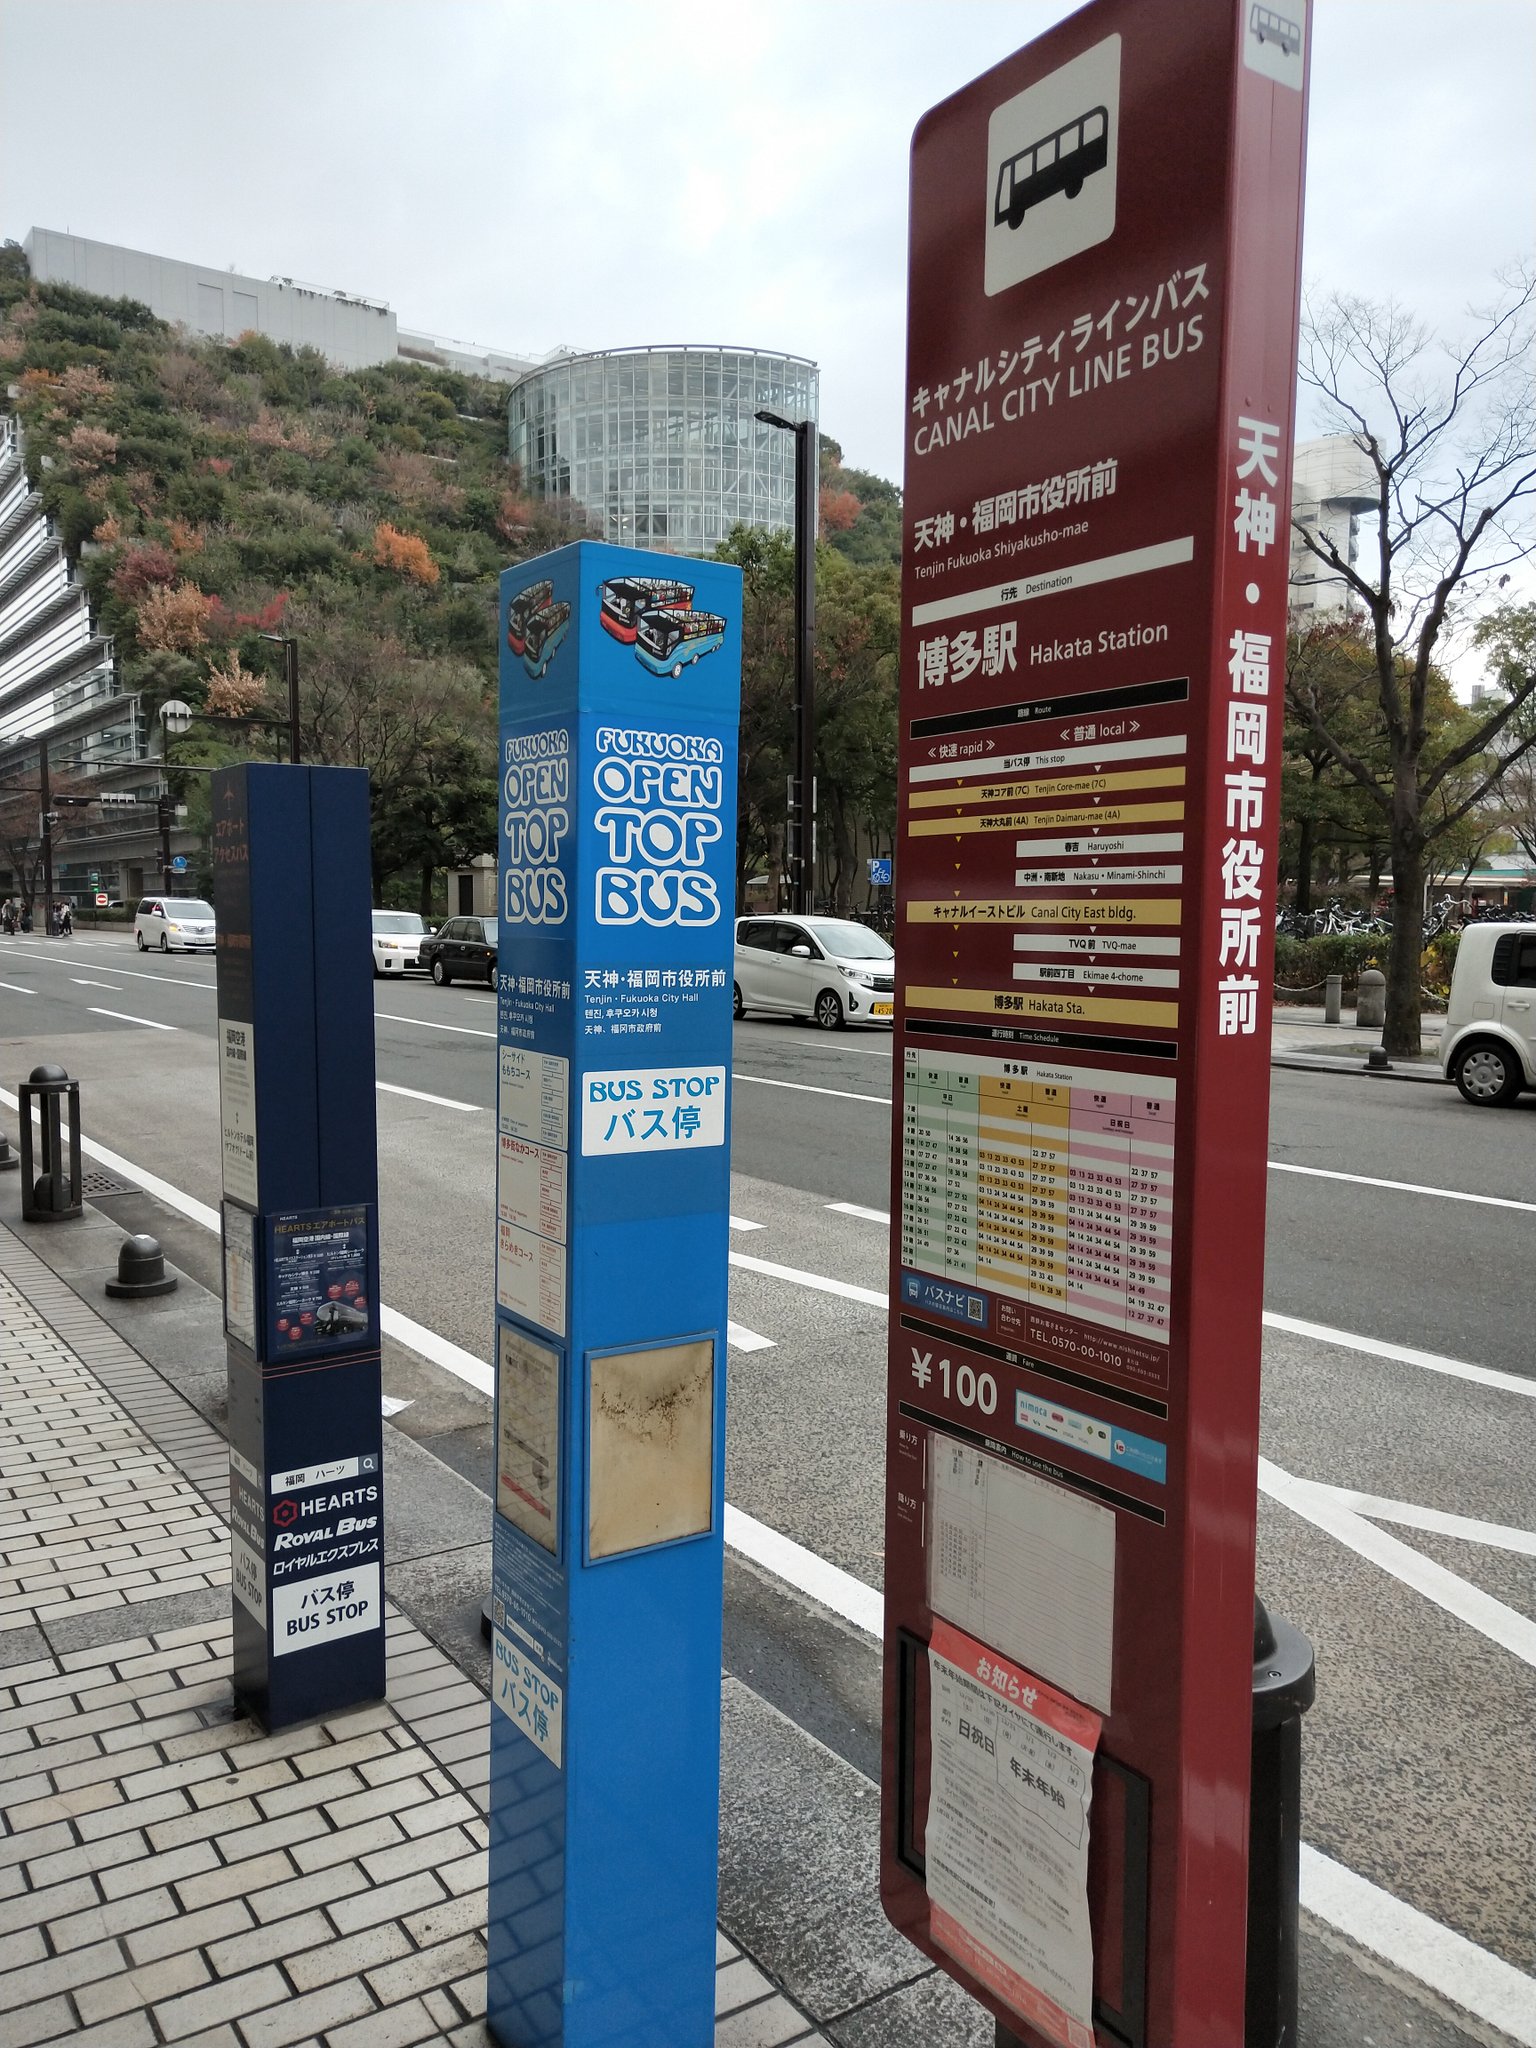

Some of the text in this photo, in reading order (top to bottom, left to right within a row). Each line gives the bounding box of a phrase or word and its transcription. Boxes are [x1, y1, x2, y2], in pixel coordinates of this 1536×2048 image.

[912, 263, 1210, 419] キャナルシティラインバス
[914, 314, 1204, 456] CANAL CITY LINE BUS
[914, 457, 1119, 554] 天神・福岡市役所前
[915, 519, 1090, 580] Tenjin Fukuoka Shiyakusho-mae
[1000, 572, 1073, 603] 行先 Destination
[917, 620, 1169, 691] 博多駅 Hakata Station
[1034, 704, 1053, 716] Route
[1074, 721, 1125, 743] 普通 local
[1217, 416, 1280, 1036] 天神・福岡市役所前
[505, 728, 569, 762] FUKUOKA
[596, 727, 723, 763] FUKUOKA
[939, 742, 983, 759] 快速 rapid
[1003, 754, 1066, 769] 当バス停 This stop
[504, 757, 569, 809] OPEN
[593, 756, 723, 809] OPEN
[1034, 783, 1056, 795] Tenjin
[1057, 780, 1090, 793] Core-mae
[1091, 778, 1107, 790] (7C)
[1034, 814, 1055, 825] Tenjin
[1056, 811, 1103, 823] Daimaru-mae
[1104, 809, 1121, 821] (4A)
[505, 806, 569, 865] TOP
[594, 806, 723, 868] TOP
[1087, 841, 1125, 852] Haruyoshi
[872, 860, 880, 873] P
[505, 866, 568, 925] BUS
[594, 866, 721, 928] BUS
[933, 904, 1137, 922] キャナルイーストビル Canal City East bldg.
[1102, 940, 1137, 951] TVQ-mae
[500, 974, 571, 1000] 天神・福岡市役所前
[584, 969, 727, 989] 天神・福岡市役所前
[1083, 970, 1110, 981] Ekimae
[1110, 972, 1144, 982] 4-chome
[534, 1002, 545, 1013] City
[585, 992, 699, 1005] Tenjin Fukuoka City Hall
[605, 1008, 640, 1019] 후쿠오카
[993, 995, 1086, 1015] 博多駅 Hakata Sta.
[1019, 1031, 1033, 1042] Time
[1033, 1032, 1060, 1044] Schedule
[501, 1064, 531, 1081] ももちコース
[1036, 1070, 1054, 1080] Hakata
[1054, 1072, 1073, 1081] Station
[589, 1076, 720, 1103] BUS STOP
[603, 1104, 701, 1141] バス停
[924, 1284, 964, 1309] バスナビ
[1022, 1357, 1035, 1369] Fare
[1030, 1328, 1122, 1368] TEL.0570-00-1010
[1020, 1399, 1048, 1418] nimoca
[284, 1464, 346, 1487] 福岡 ハーツ
[1011, 1450, 1022, 1461] How
[1023, 1454, 1031, 1464] to
[1032, 1459, 1042, 1469] use
[1042, 1461, 1052, 1473] the
[1053, 1466, 1064, 1479] bus
[238, 1484, 265, 1523] HEARTS
[301, 1485, 378, 1517] HEARTS
[239, 1551, 258, 1581] バス停
[273, 1537, 379, 1576] ロイヤルエクスプレス
[235, 1566, 263, 1609] BUS STOP
[301, 1580, 355, 1610] バス停
[286, 1600, 369, 1637] BUS STOP
[496, 1637, 520, 1677] BUS
[522, 1664, 559, 1712] STOP
[976, 1656, 1039, 1710] お知らせ
[501, 1678, 549, 1742] バス停
[958, 1717, 995, 1757] 日祝日
[1009, 1756, 1066, 1810] 年末年始
